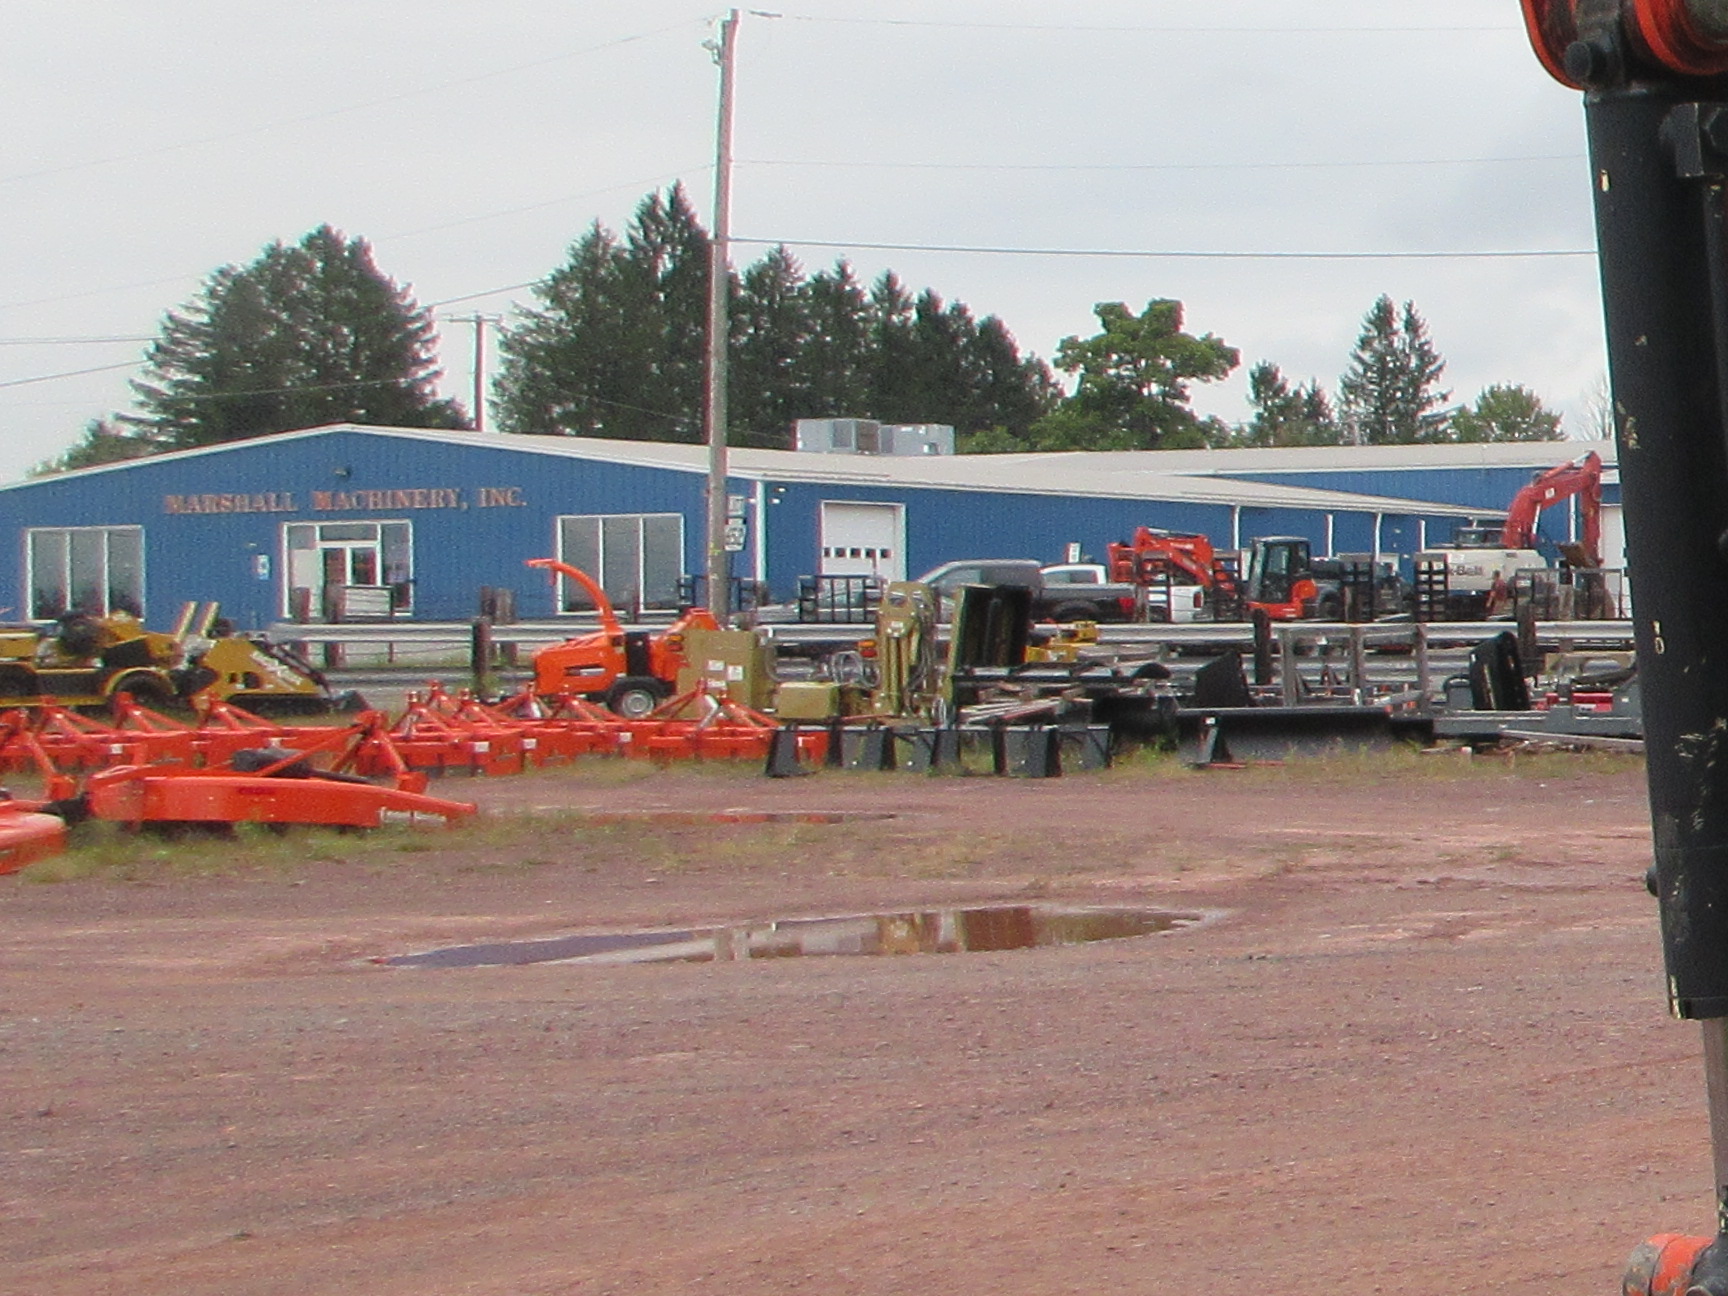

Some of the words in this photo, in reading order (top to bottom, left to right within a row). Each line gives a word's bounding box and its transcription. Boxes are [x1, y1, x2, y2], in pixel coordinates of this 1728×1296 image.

[164, 492, 298, 514] MARSHALL
[311, 489, 468, 512] MACHINERY,
[477, 487, 527, 508] INC.
